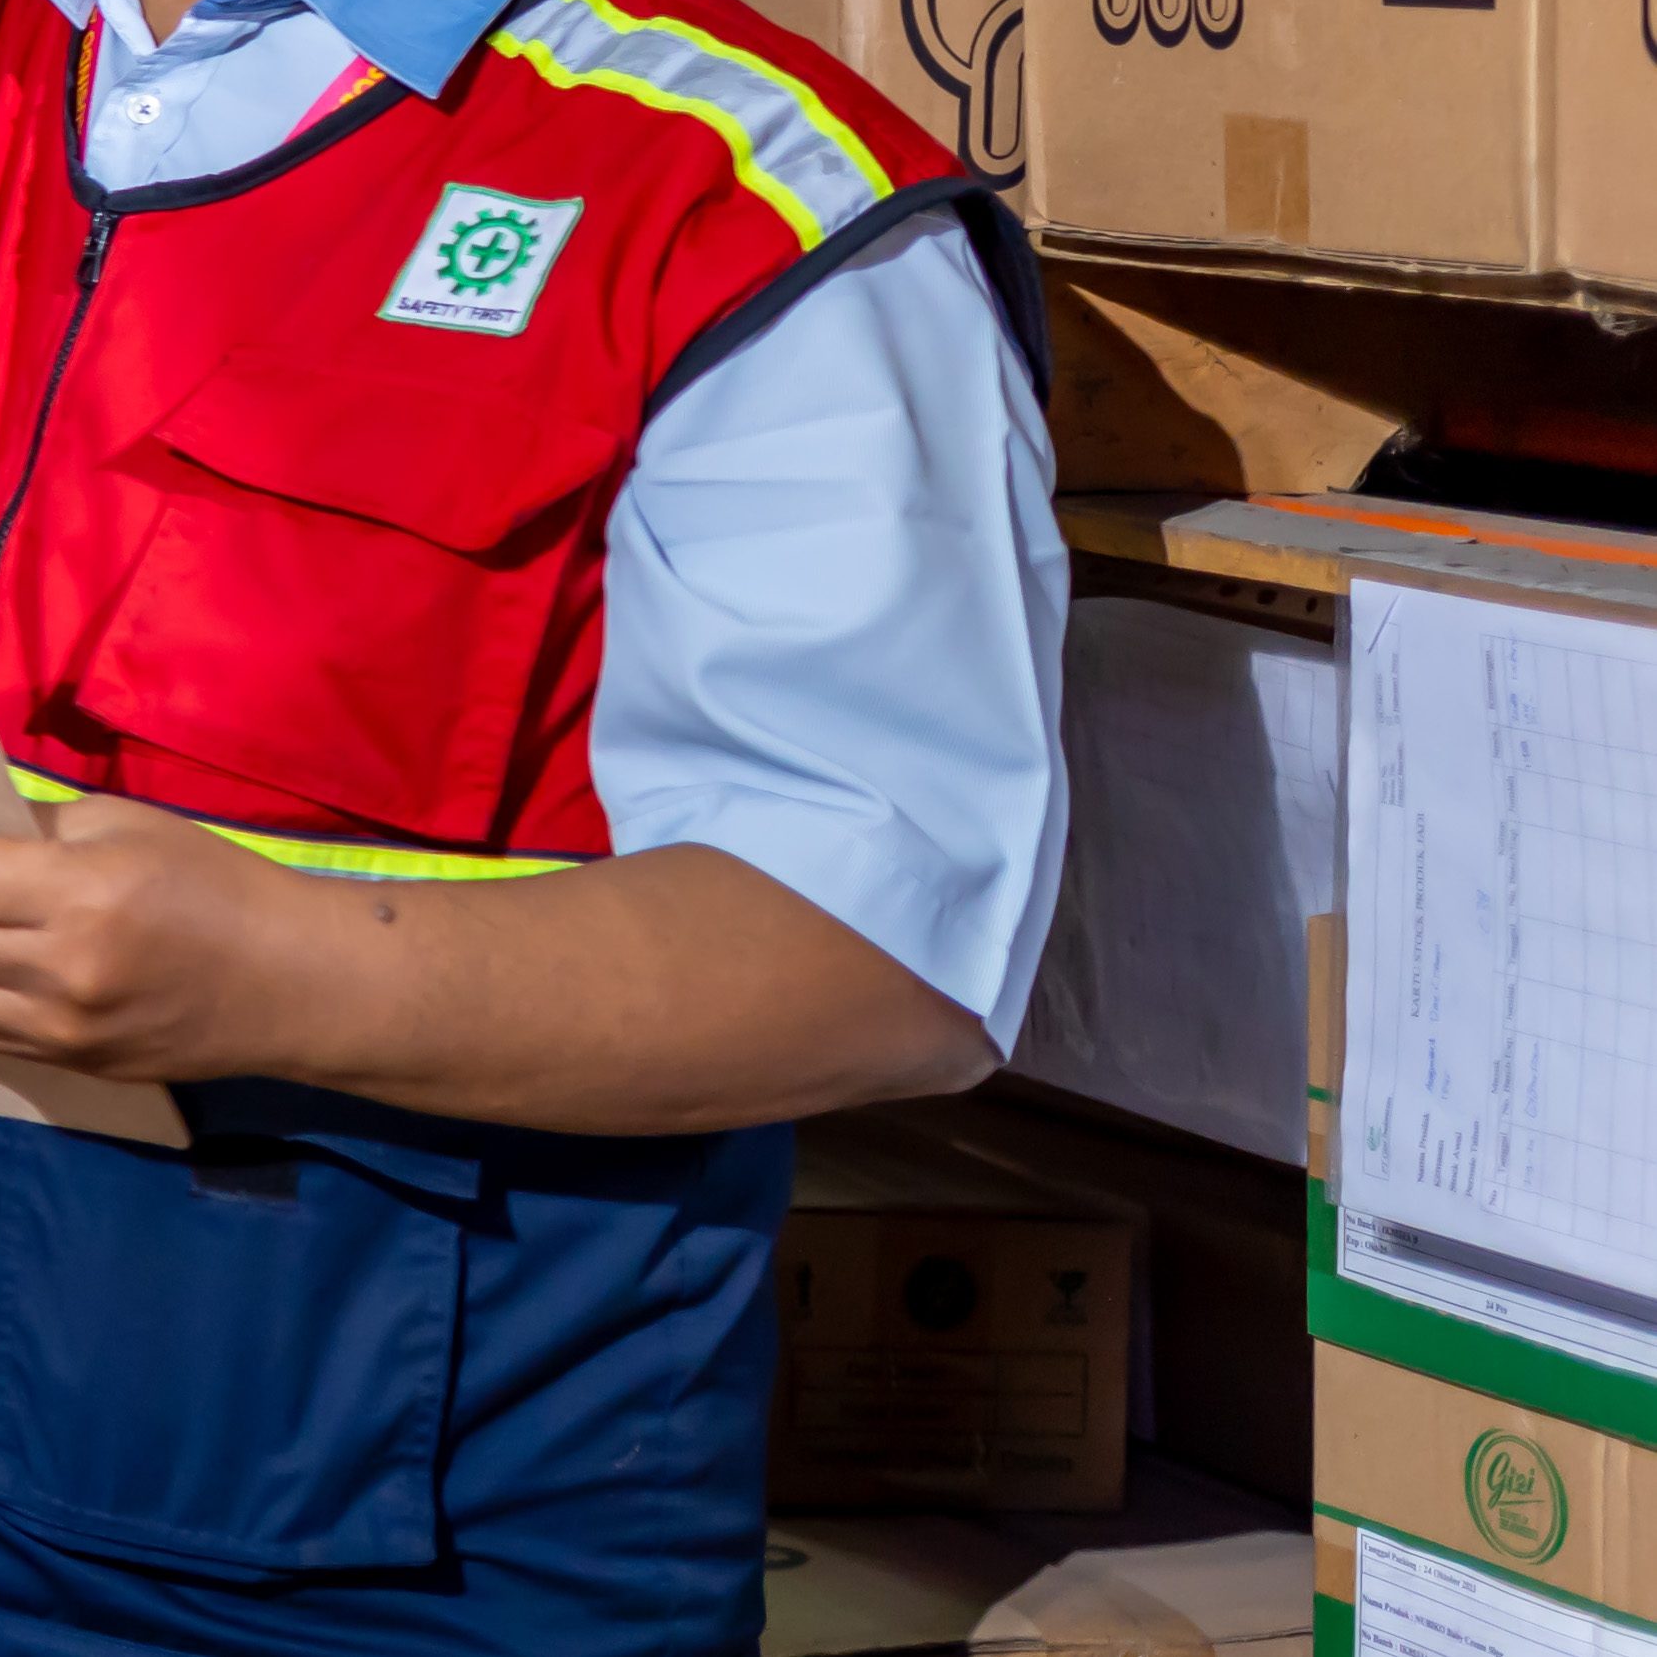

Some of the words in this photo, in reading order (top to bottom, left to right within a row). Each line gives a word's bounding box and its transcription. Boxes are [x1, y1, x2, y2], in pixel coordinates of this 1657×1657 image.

[396, 295, 462, 321] SAFETY
[468, 303, 522, 327] FIRST
[1412, 915, 1425, 963] STOCK
[1409, 967, 1422, 1019] KARTU
